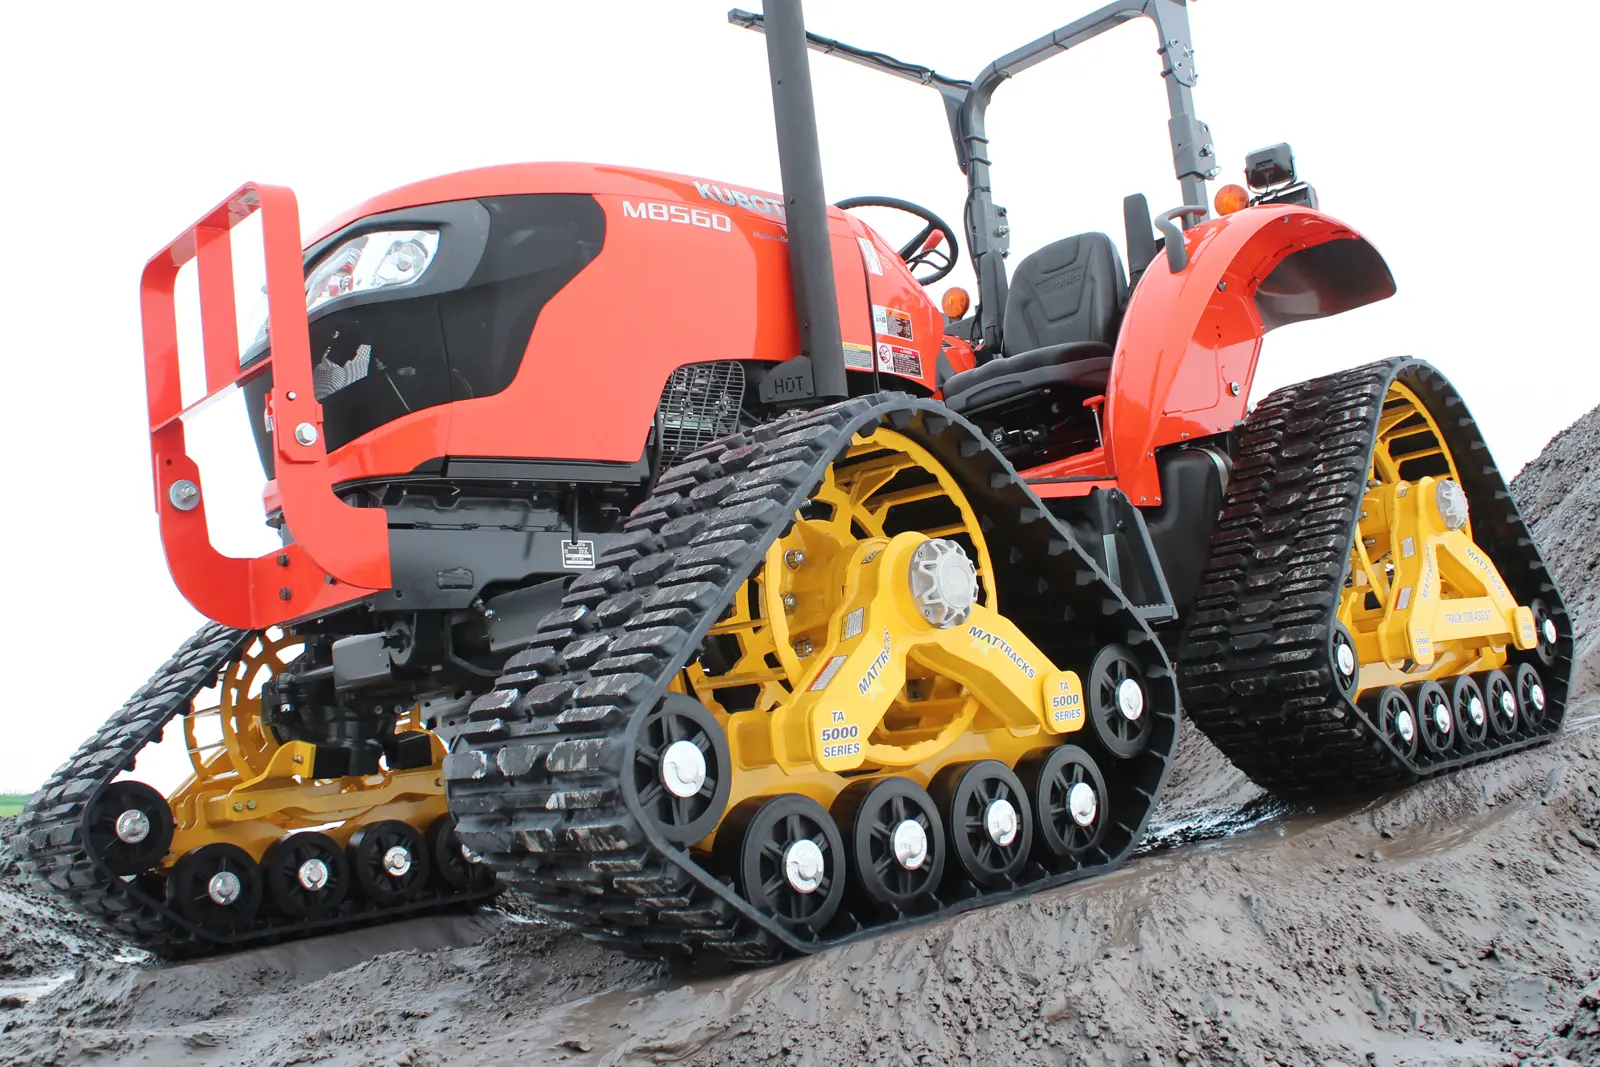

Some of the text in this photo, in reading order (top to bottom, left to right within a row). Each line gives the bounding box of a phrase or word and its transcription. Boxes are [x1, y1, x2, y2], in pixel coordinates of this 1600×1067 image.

[693, 180, 786, 218] KUBOT
[622, 200, 732, 233] M8560
[773, 375, 804, 395] HOT
[967, 625, 1036, 680] MATTRACKS
[857, 627, 892, 697] MATTRACKS
[1058, 680, 1070, 693] TA
[1052, 693, 1080, 708] 5000
[830, 710, 846, 723] TA
[1053, 708, 1082, 722] SERIES
[821, 726, 859, 742] 5000
[823, 742, 861, 759] SERIES
